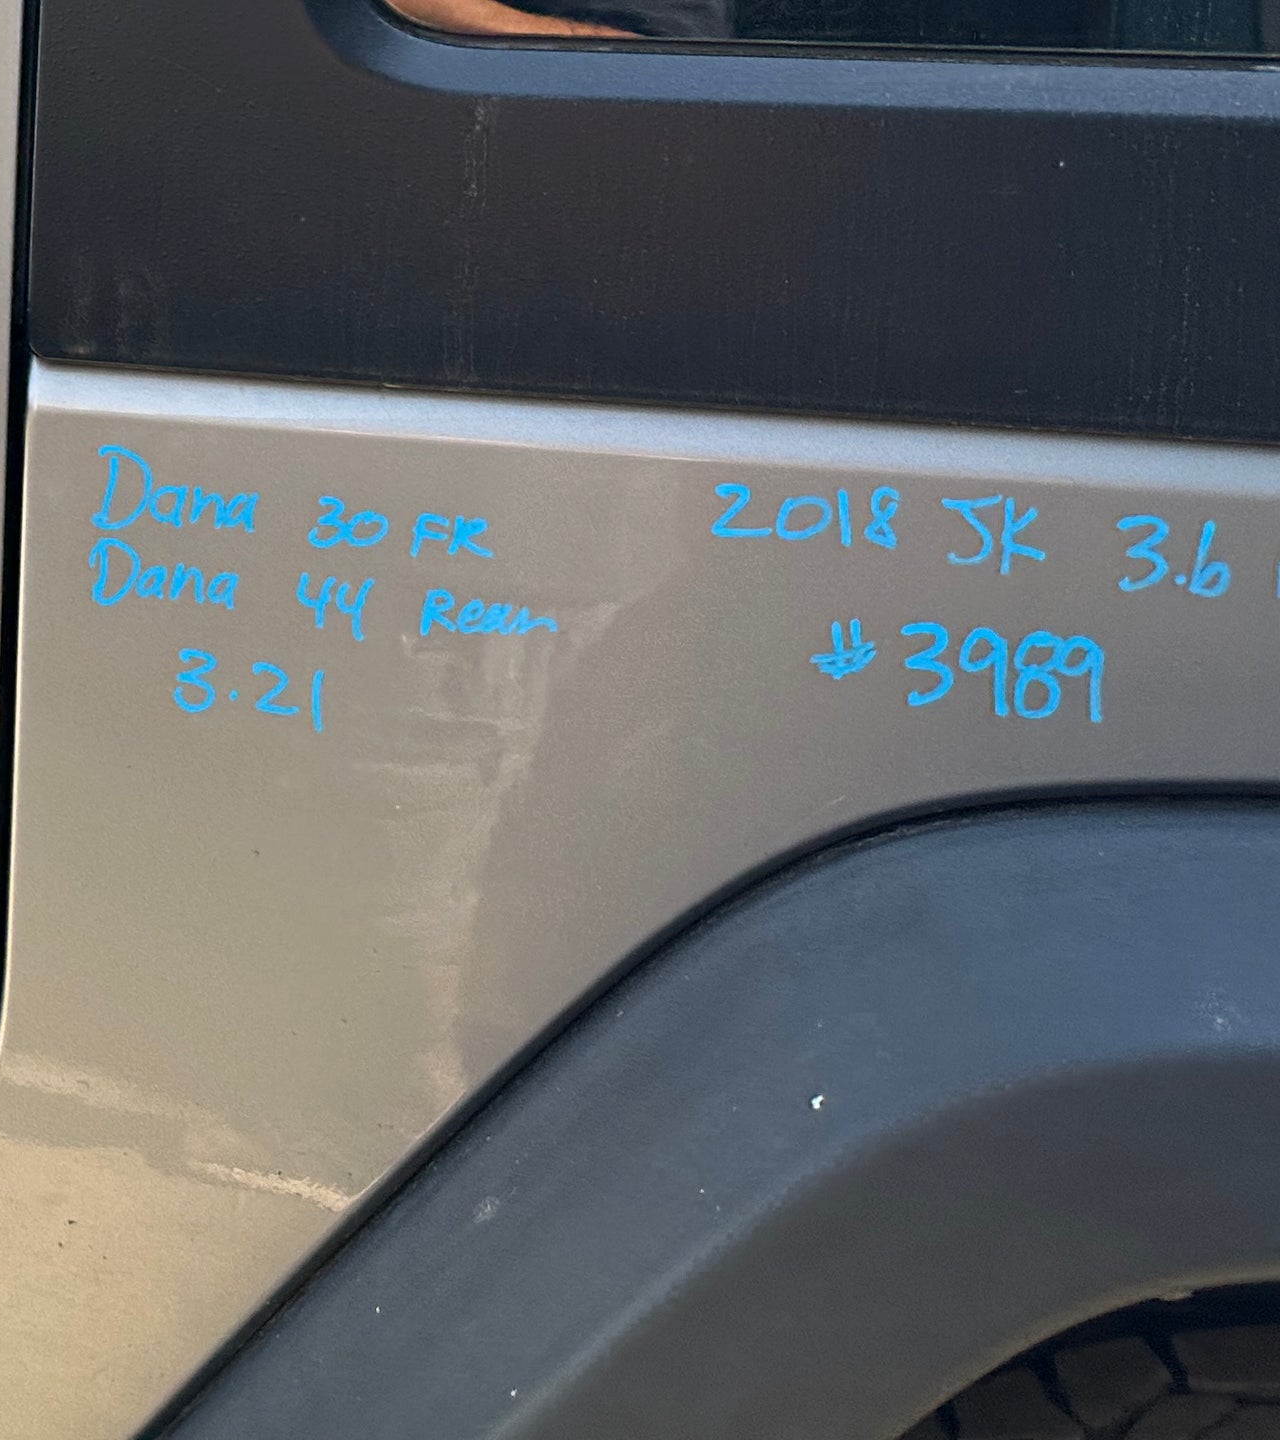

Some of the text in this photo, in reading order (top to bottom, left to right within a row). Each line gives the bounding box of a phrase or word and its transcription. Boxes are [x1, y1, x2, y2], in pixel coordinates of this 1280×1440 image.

[91, 444, 494, 558] Dana 30 FR
[711, 482, 901, 549] 2018
[941, 494, 1047, 574] JK
[1116, 514, 1232, 597] 3.6
[89, 537, 240, 607] Dana
[296, 572, 375, 641] 44
[173, 648, 324, 732] 3.21
